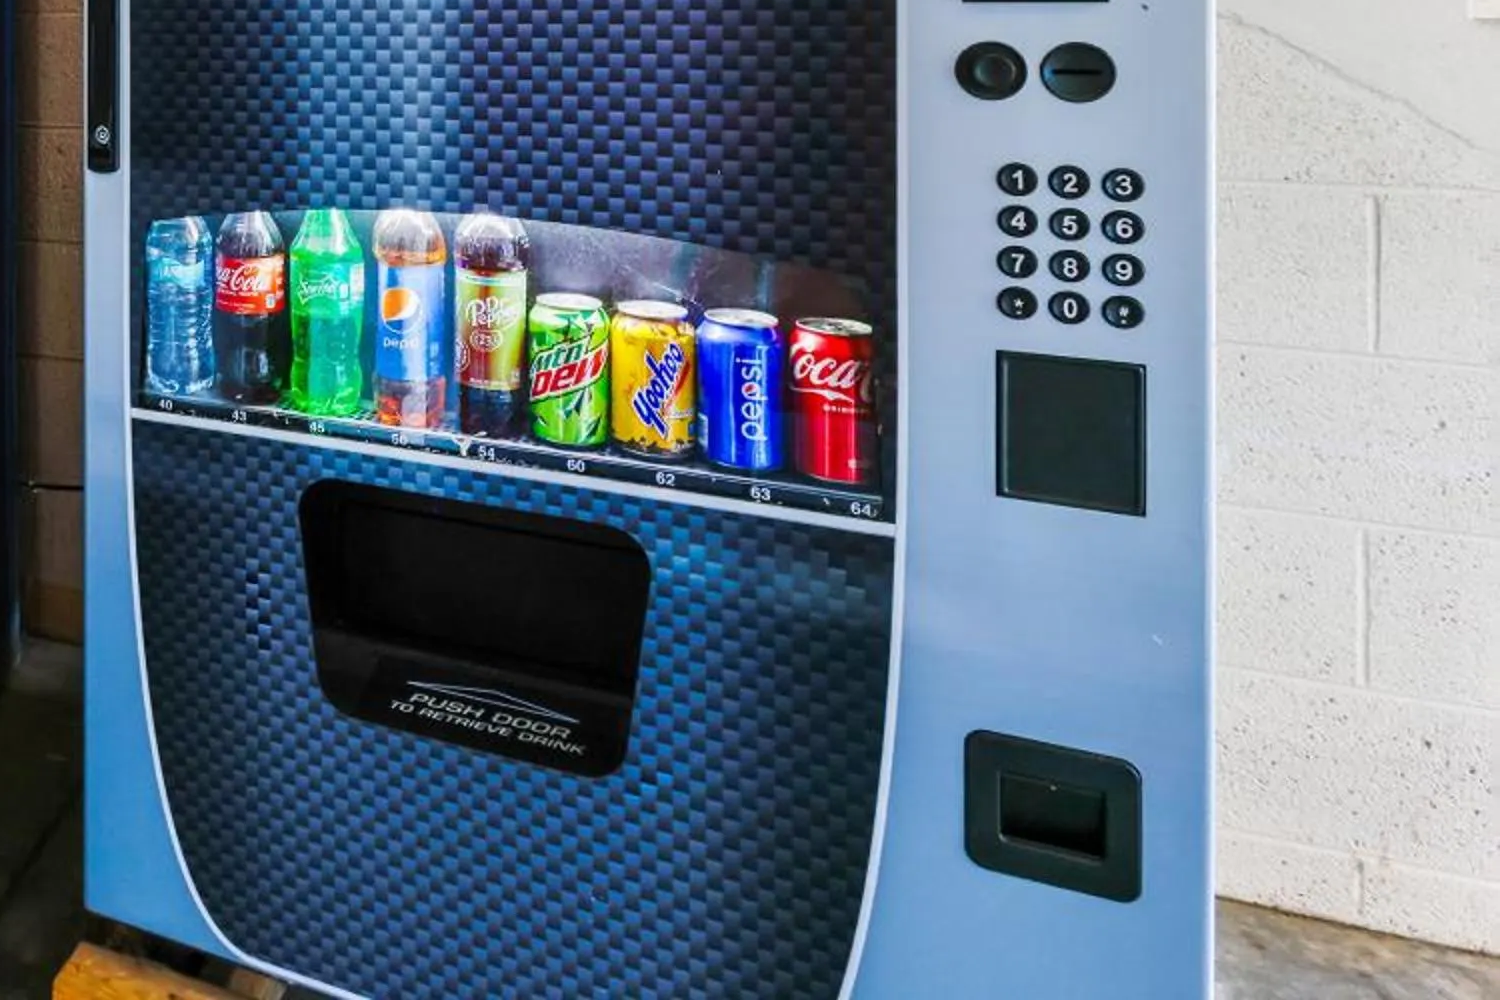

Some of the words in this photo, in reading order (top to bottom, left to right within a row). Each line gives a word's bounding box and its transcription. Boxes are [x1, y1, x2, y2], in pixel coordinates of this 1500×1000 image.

[1012, 169, 1025, 191] 1
[1063, 173, 1079, 193] 2
[1115, 175, 1133, 195] 3
[1011, 211, 1027, 231] 4
[1062, 215, 1079, 235] 5
[1115, 218, 1134, 238] 6
[1011, 253, 1025, 273] 7
[1063, 257, 1079, 278] 8
[1115, 260, 1133, 281] 9
[1063, 299, 1078, 318] 0
[158, 399, 173, 411] 40
[736, 357, 768, 441] pepsi
[231, 410, 247, 422] 43
[567, 459, 585, 473] 60
[655, 472, 675, 486] 62
[751, 486, 771, 501] 63
[850, 502, 872, 516] 64
[409, 693, 485, 718] PUSH
[492, 712, 572, 739] DOOR
[390, 700, 415, 713] TO
[418, 709, 513, 737] RETRIEVE
[517, 731, 587, 755] DRINK
